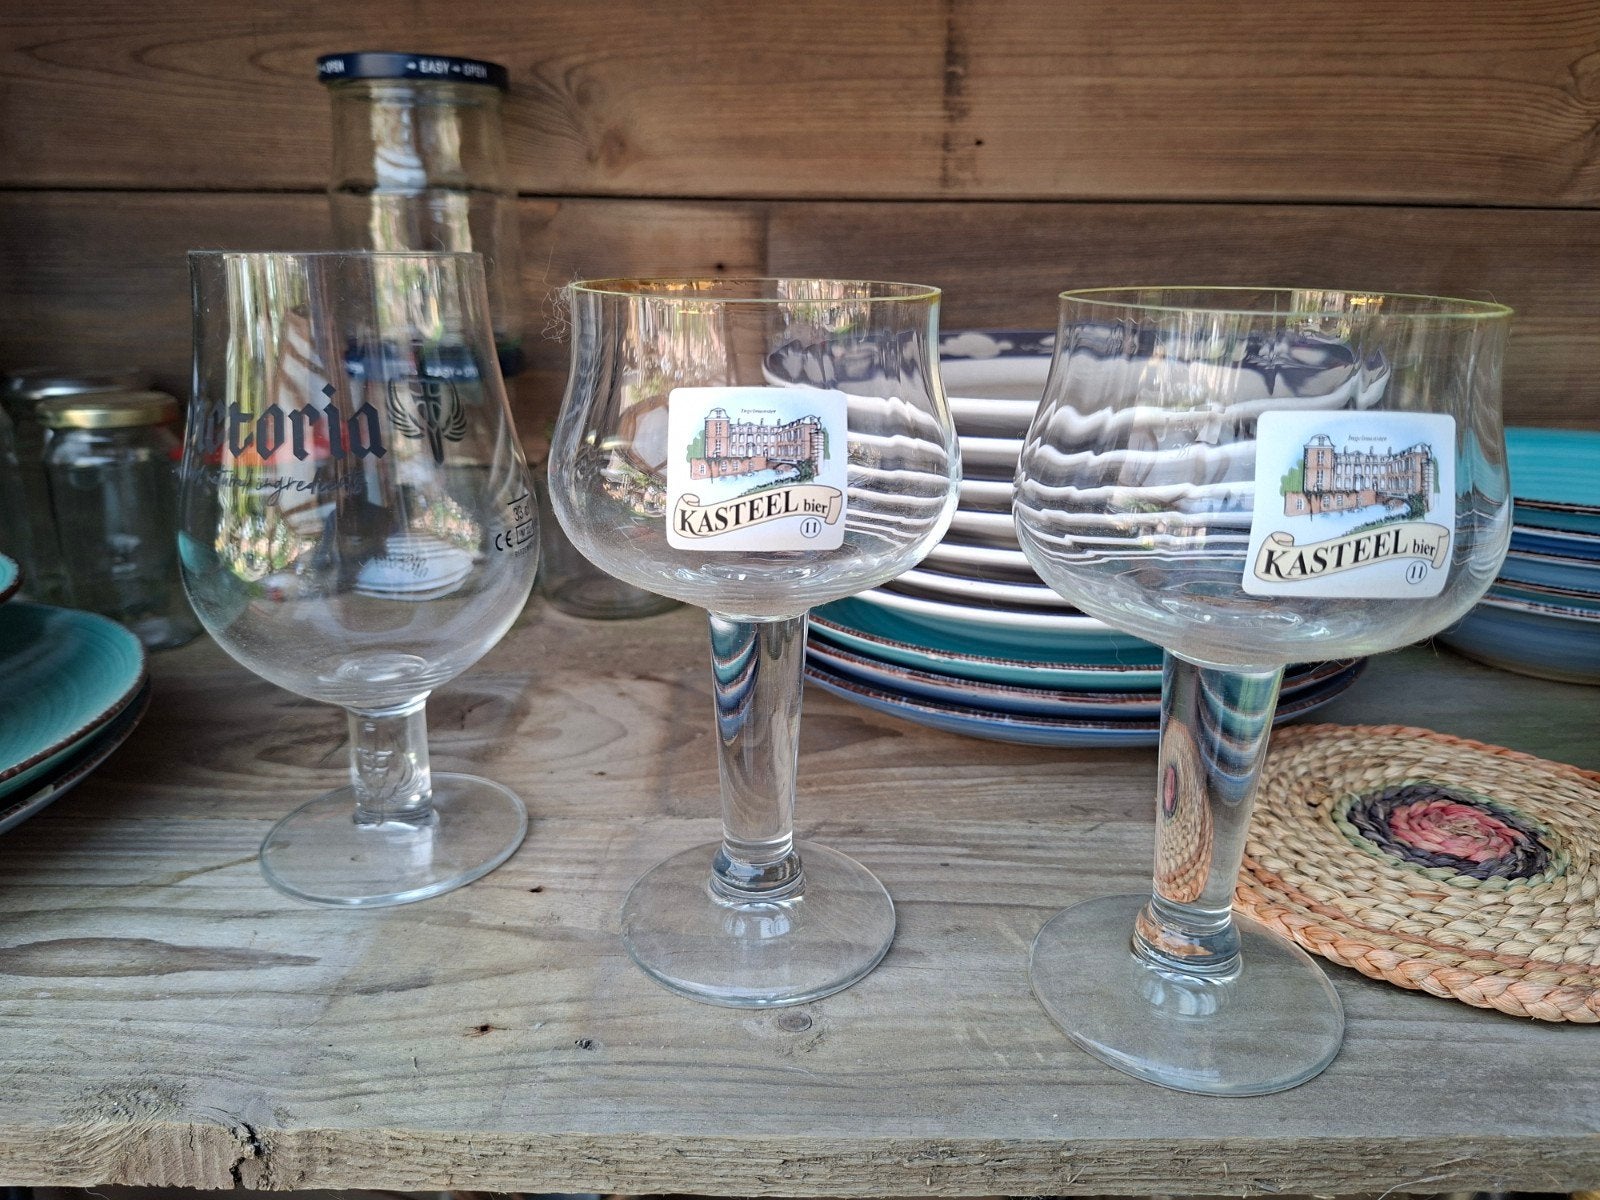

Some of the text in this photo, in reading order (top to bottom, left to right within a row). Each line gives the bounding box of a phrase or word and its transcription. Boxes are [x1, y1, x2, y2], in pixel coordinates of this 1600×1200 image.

[419, 60, 488, 78] EASY OPEN
[680, 490, 829, 537] KASTEEL bier
[1261, 528, 1436, 579] KASTEEL bier
